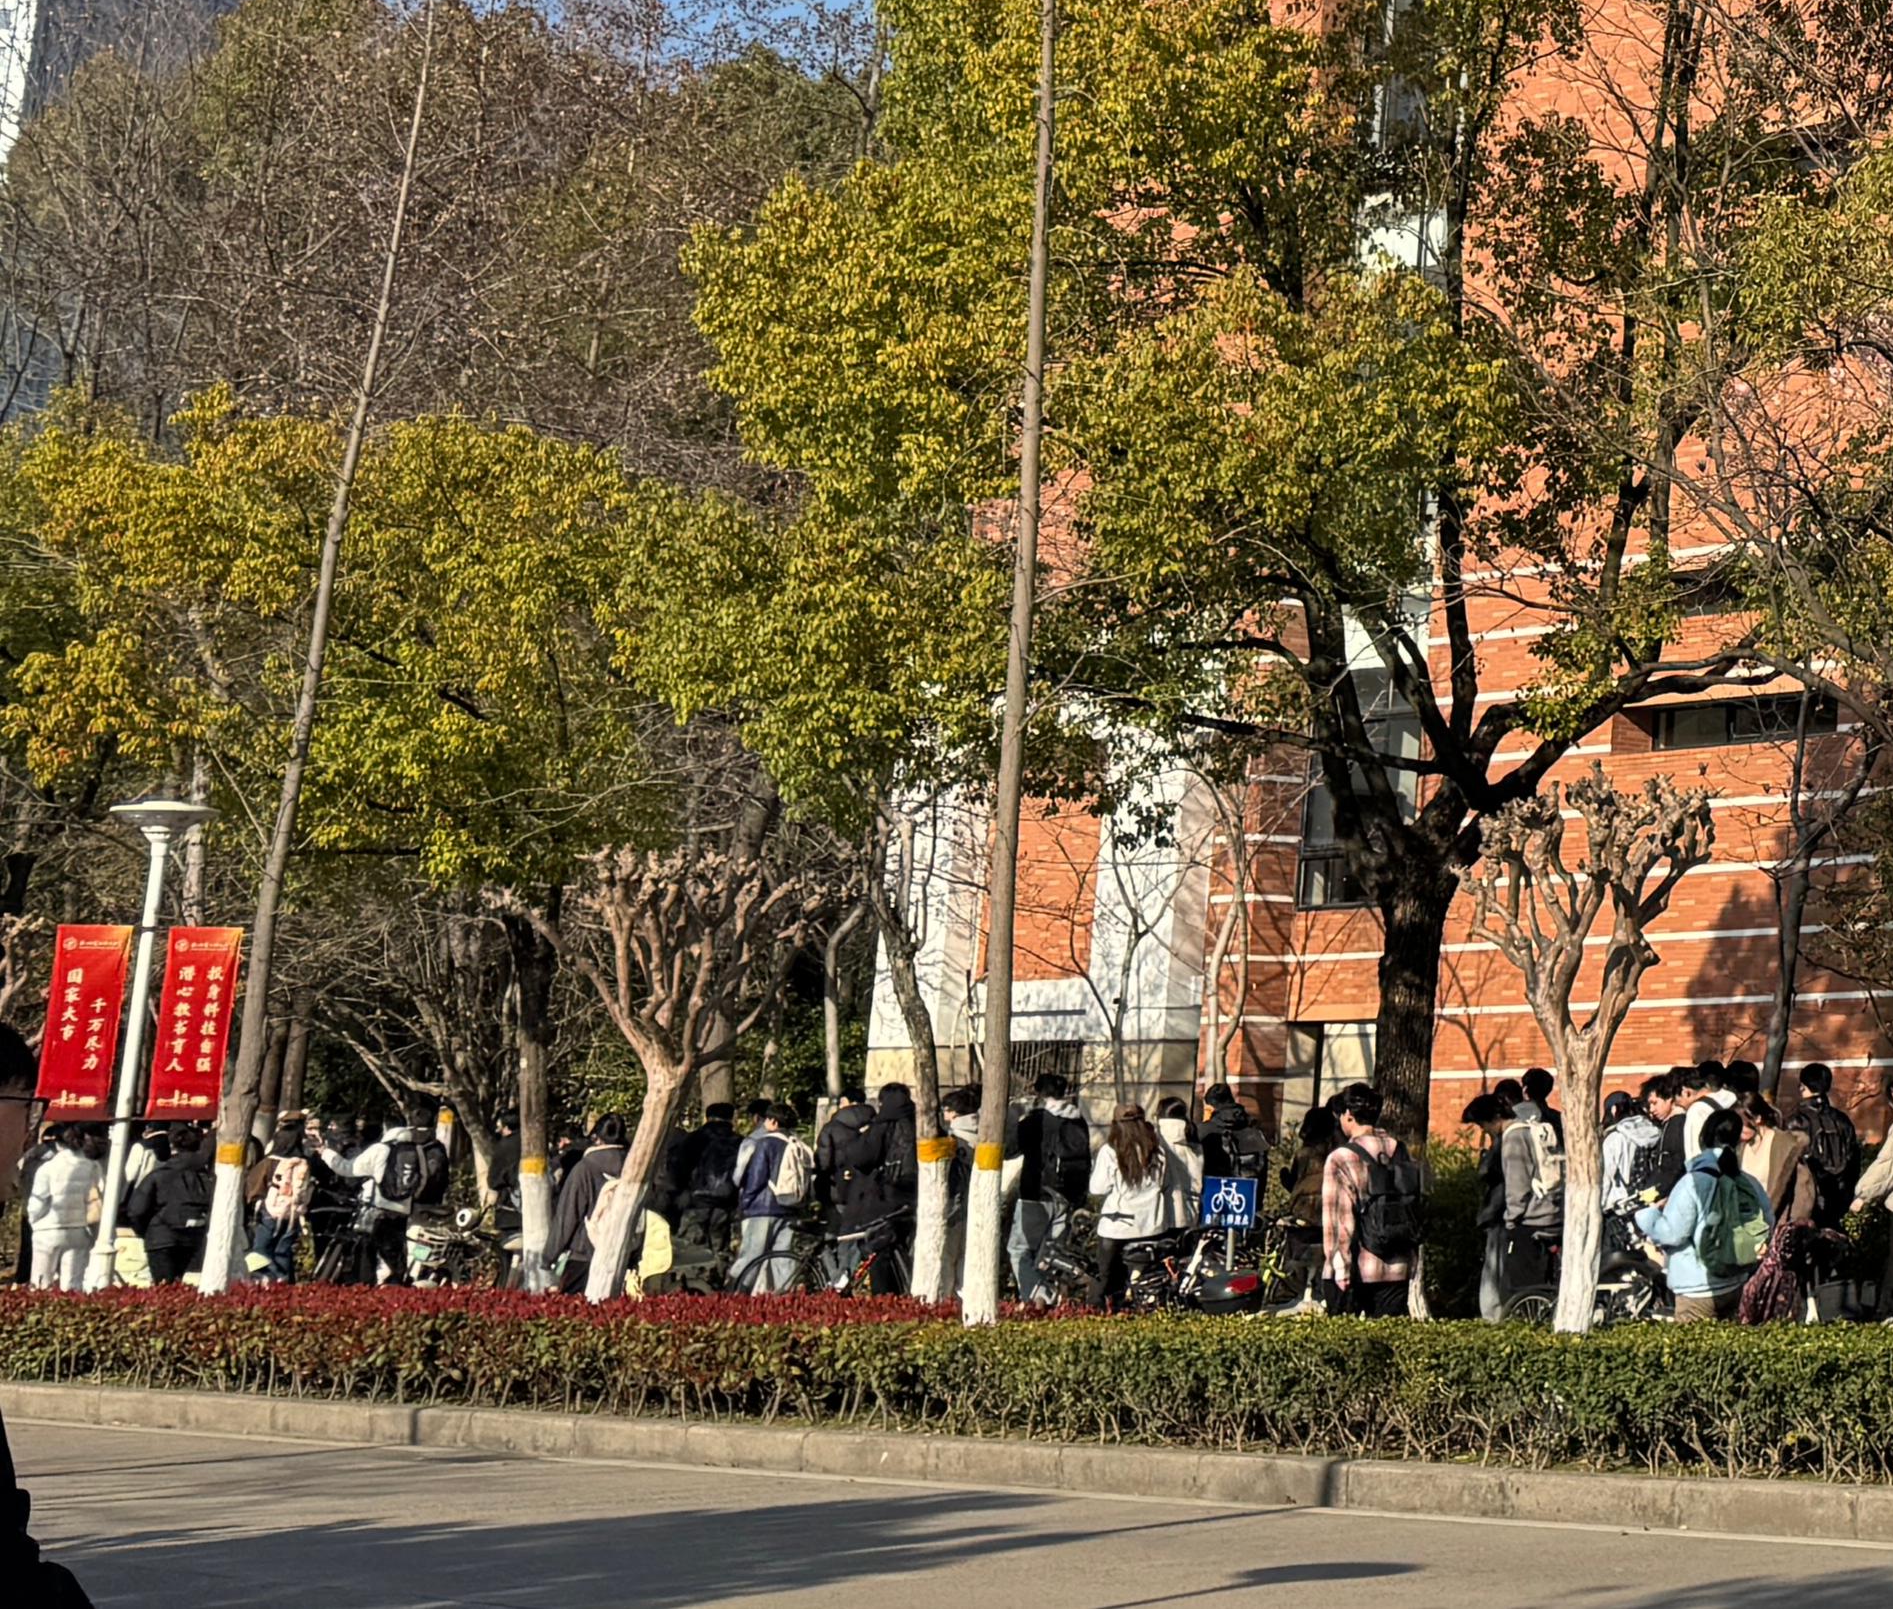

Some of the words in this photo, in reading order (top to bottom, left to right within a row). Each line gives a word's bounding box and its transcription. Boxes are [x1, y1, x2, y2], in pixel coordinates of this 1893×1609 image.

[60, 967, 84, 1042] 国家大事
[81, 997, 107, 1071] 千万尽力
